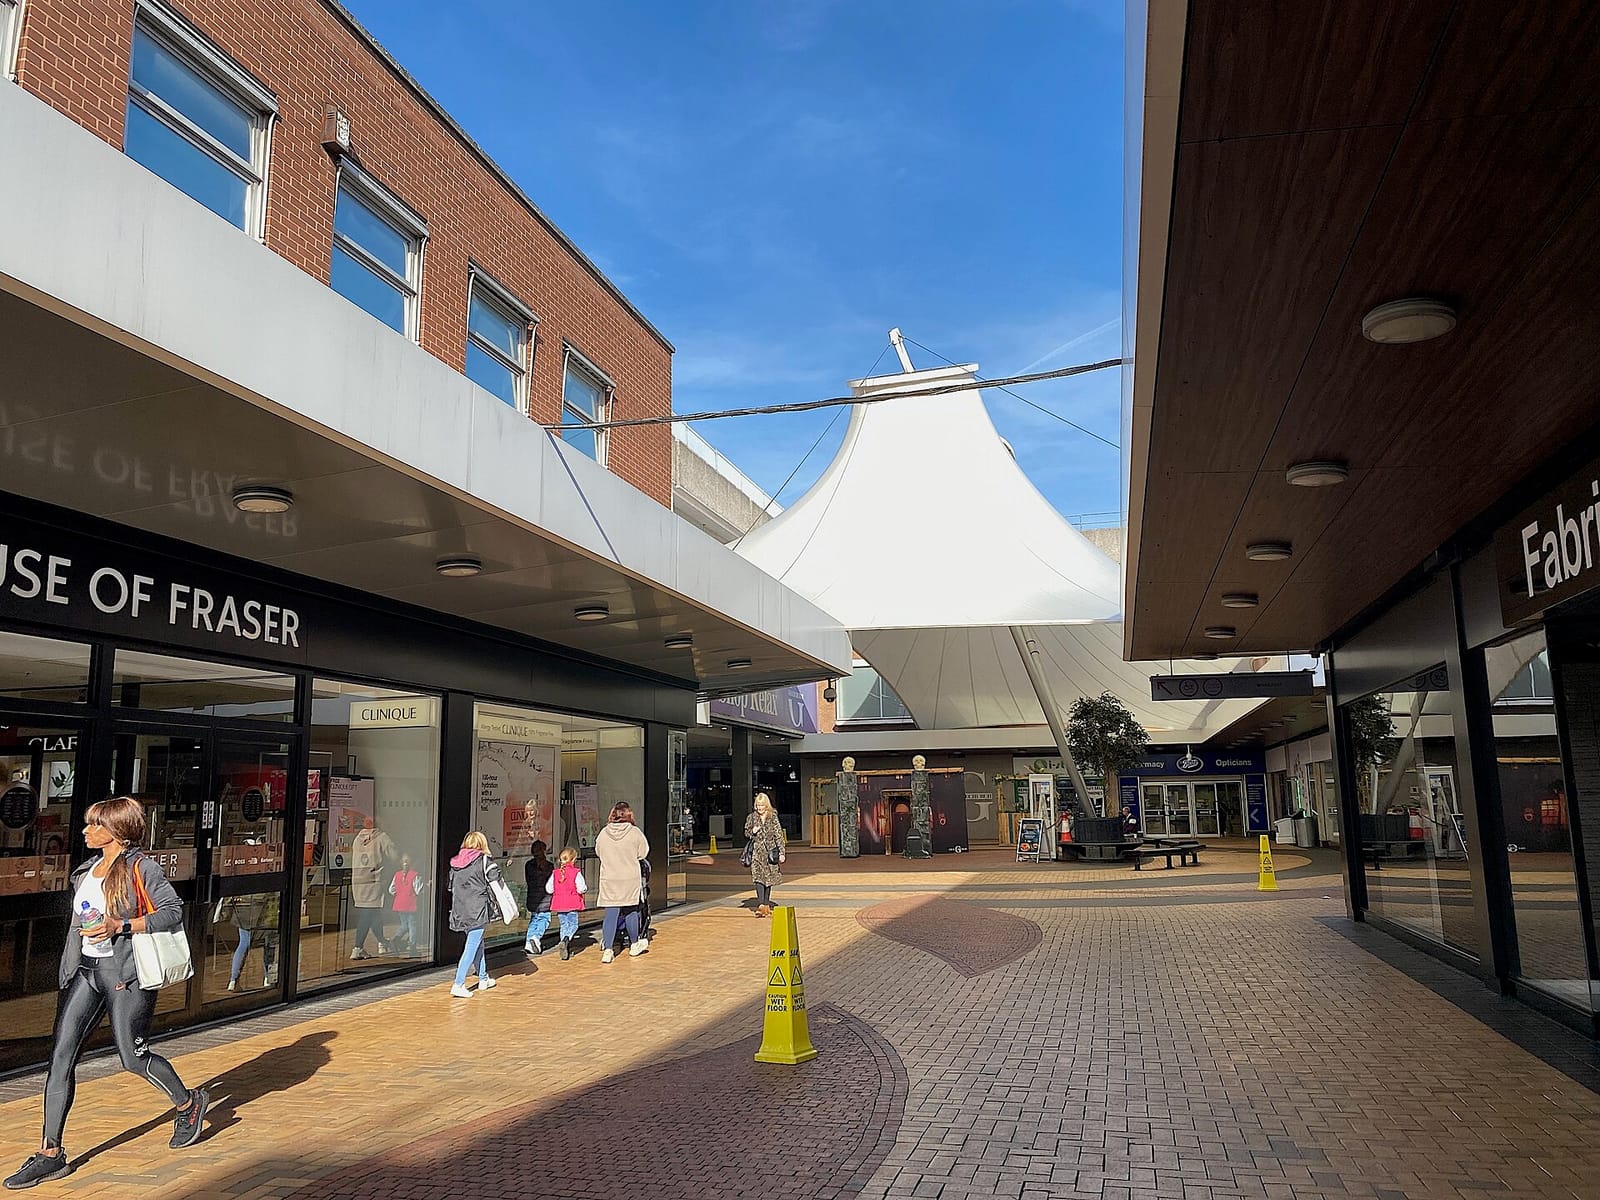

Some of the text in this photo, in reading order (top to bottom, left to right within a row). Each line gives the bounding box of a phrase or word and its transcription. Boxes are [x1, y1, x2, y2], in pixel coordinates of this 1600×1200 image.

[1522, 480, 1600, 598] Fabri
[89, 567, 154, 618] OF
[169, 583, 300, 648] FRASER
[361, 707, 416, 721] CLINIQUE
[502, 724, 528, 738] CLINIQUE
[1215, 758, 1252, 767] Opticians
